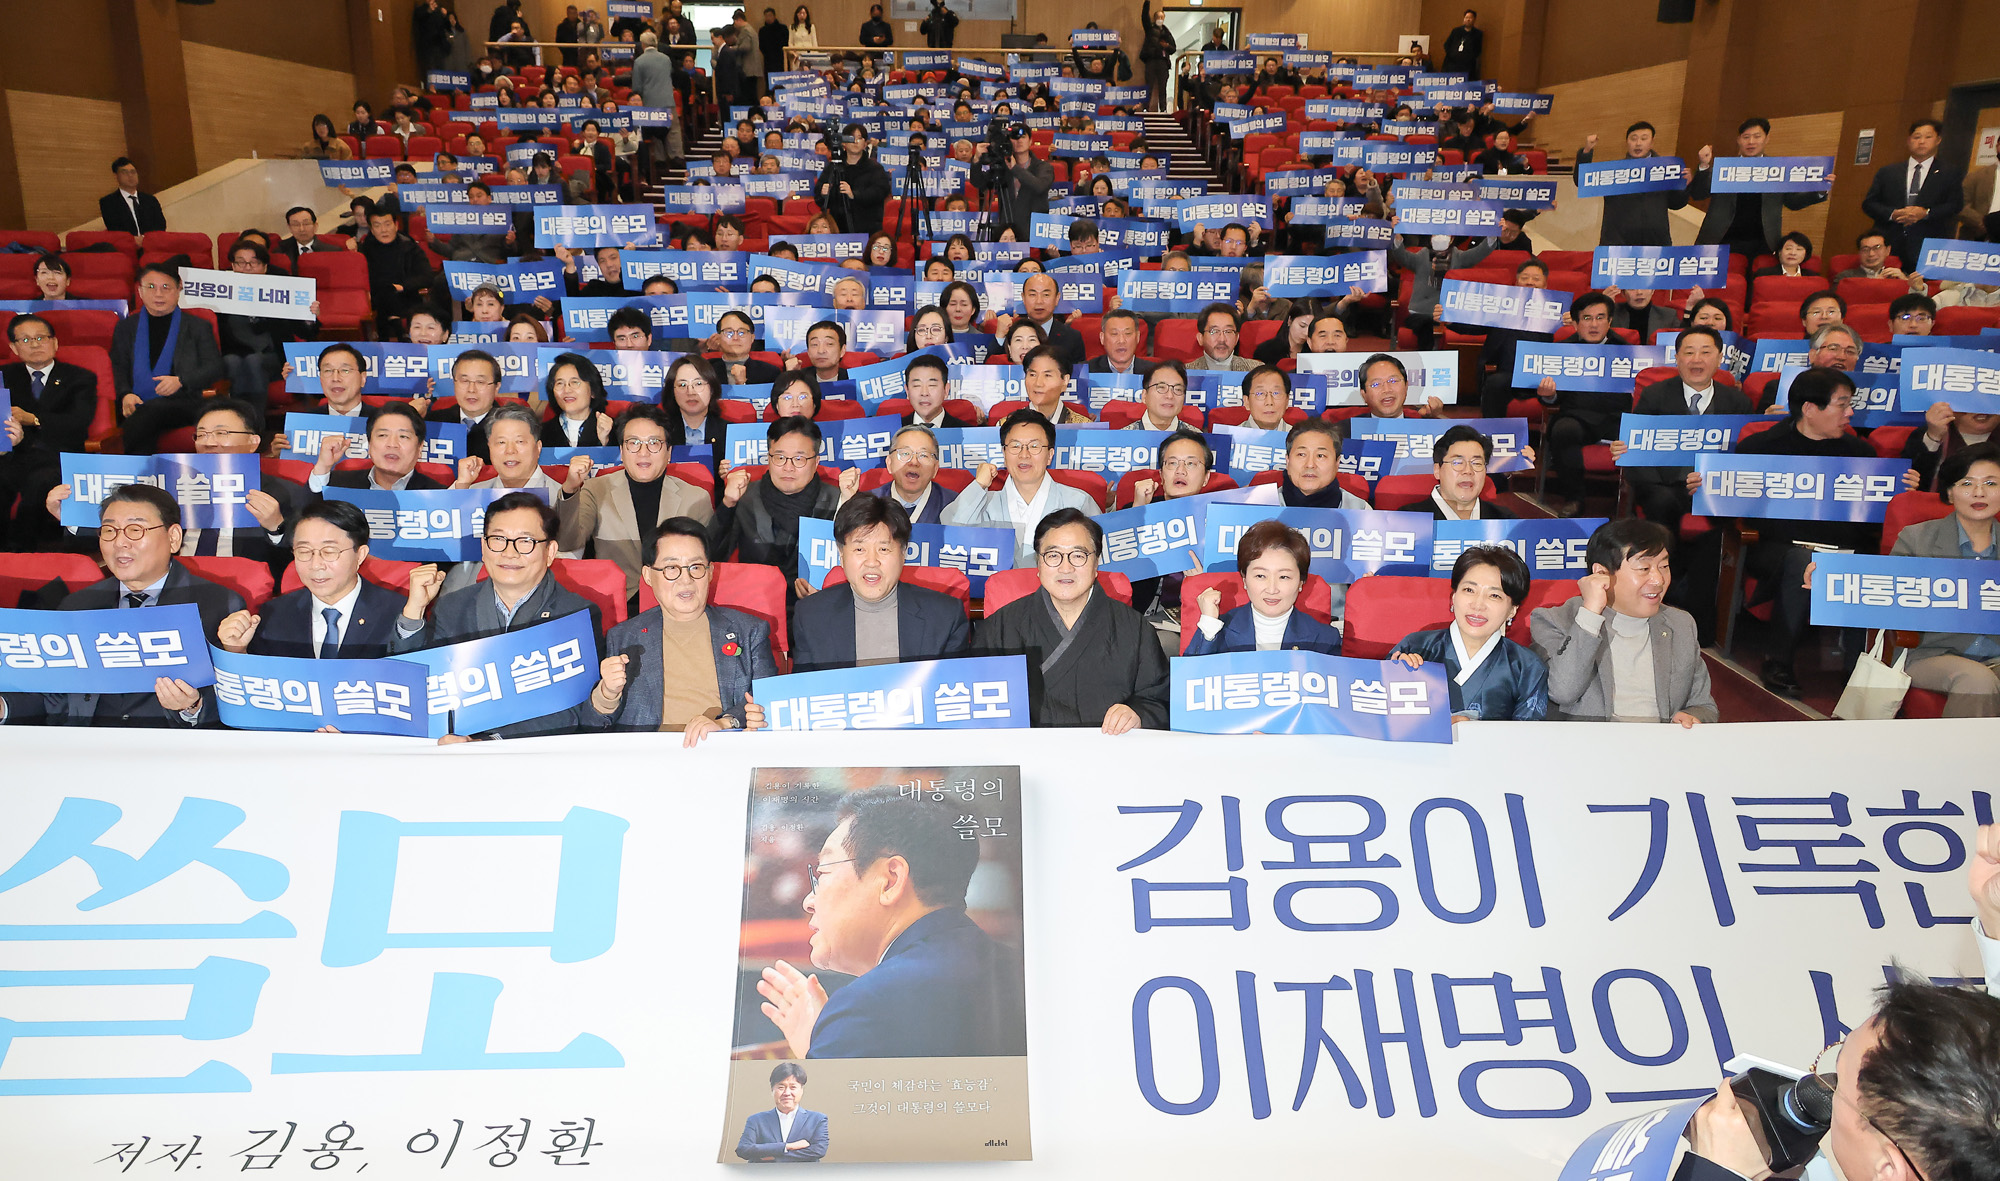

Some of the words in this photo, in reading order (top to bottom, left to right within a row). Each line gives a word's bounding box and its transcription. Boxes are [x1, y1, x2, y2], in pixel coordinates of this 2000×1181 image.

[1584, 168, 1645, 187] 대통령의
[1650, 164, 1682, 183] 쓸모
[1718, 166, 1784, 183] 대통령의
[1789, 165, 1824, 183] 쓸모
[1182, 203, 1239, 222] 대통령의
[1241, 202, 1267, 219] 쓸모
[1401, 208, 1461, 225] 대통령의
[1465, 209, 1496, 226] 쓸모
[540, 216, 607, 236] 대통령의
[611, 214, 648, 235] 쓸모
[834, 241, 864, 257] 쓸모
[701, 262, 738, 281] 쓸모
[1271, 265, 1340, 286] 대통령의
[1343, 260, 1380, 283] 쓸모
[1599, 255, 1675, 276] 대통령의
[1679, 256, 1719, 276] 쓸모
[183, 280, 233, 300] 김용의
[258, 287, 290, 305] 너머
[518, 271, 557, 291] 쓸모
[1062, 282, 1096, 301] 쓸모
[1123, 280, 1193, 300] 대통령의
[1196, 282, 1231, 301] 쓸모
[872, 286, 907, 305] 쓸모
[1445, 291, 1519, 314] 대통령의
[1523, 299, 1563, 322] 쓸모
[649, 306, 688, 327] 쓸모
[855, 321, 895, 343] 쓸모
[383, 355, 429, 379] 쓸모
[1432, 367, 1451, 387] 꿈
[1523, 353, 1606, 377] 대통령의
[1629, 428, 1731, 451] 대통령의
[1057, 445, 1158, 472] 대통령의
[176, 472, 247, 506] 쓸모
[1706, 470, 1825, 500] 대통령의
[1833, 473, 1895, 502] 쓸모
[1352, 528, 1416, 563] 쓸모
[938, 540, 999, 577] 쓸모
[1826, 572, 1969, 610] 대통령의
[96, 629, 189, 669] 쓸모
[510, 637, 586, 693] 쓸모
[215, 665, 324, 716] 통령의
[333, 679, 413, 722] 쓸모
[1185, 670, 1340, 712] 대통령의
[1349, 677, 1431, 716] 쓸모
[770, 685, 925, 731] 대통령의
[934, 680, 1011, 723] 쓸모
[898, 777, 1004, 802] 대통령의
[951, 813, 1009, 841] 쓸모
[1116, 790, 1547, 934] 김용이
[1586, 788, 2000, 931] 기록한
[0, 795, 631, 1097] 쓸모
[1131, 964, 1736, 1122] 이재명의
[847, 1079, 886, 1093] 국민이
[891, 1079, 942, 1093] 체감하는
[852, 1101, 891, 1115] 그것이
[896, 1100, 948, 1114] 대통령의
[952, 1099, 992, 1115] 쓸모다
[93, 1134, 203, 1173] 저자.
[229, 1119, 369, 1175] 김용,
[404, 1117, 604, 1170] 이정환
